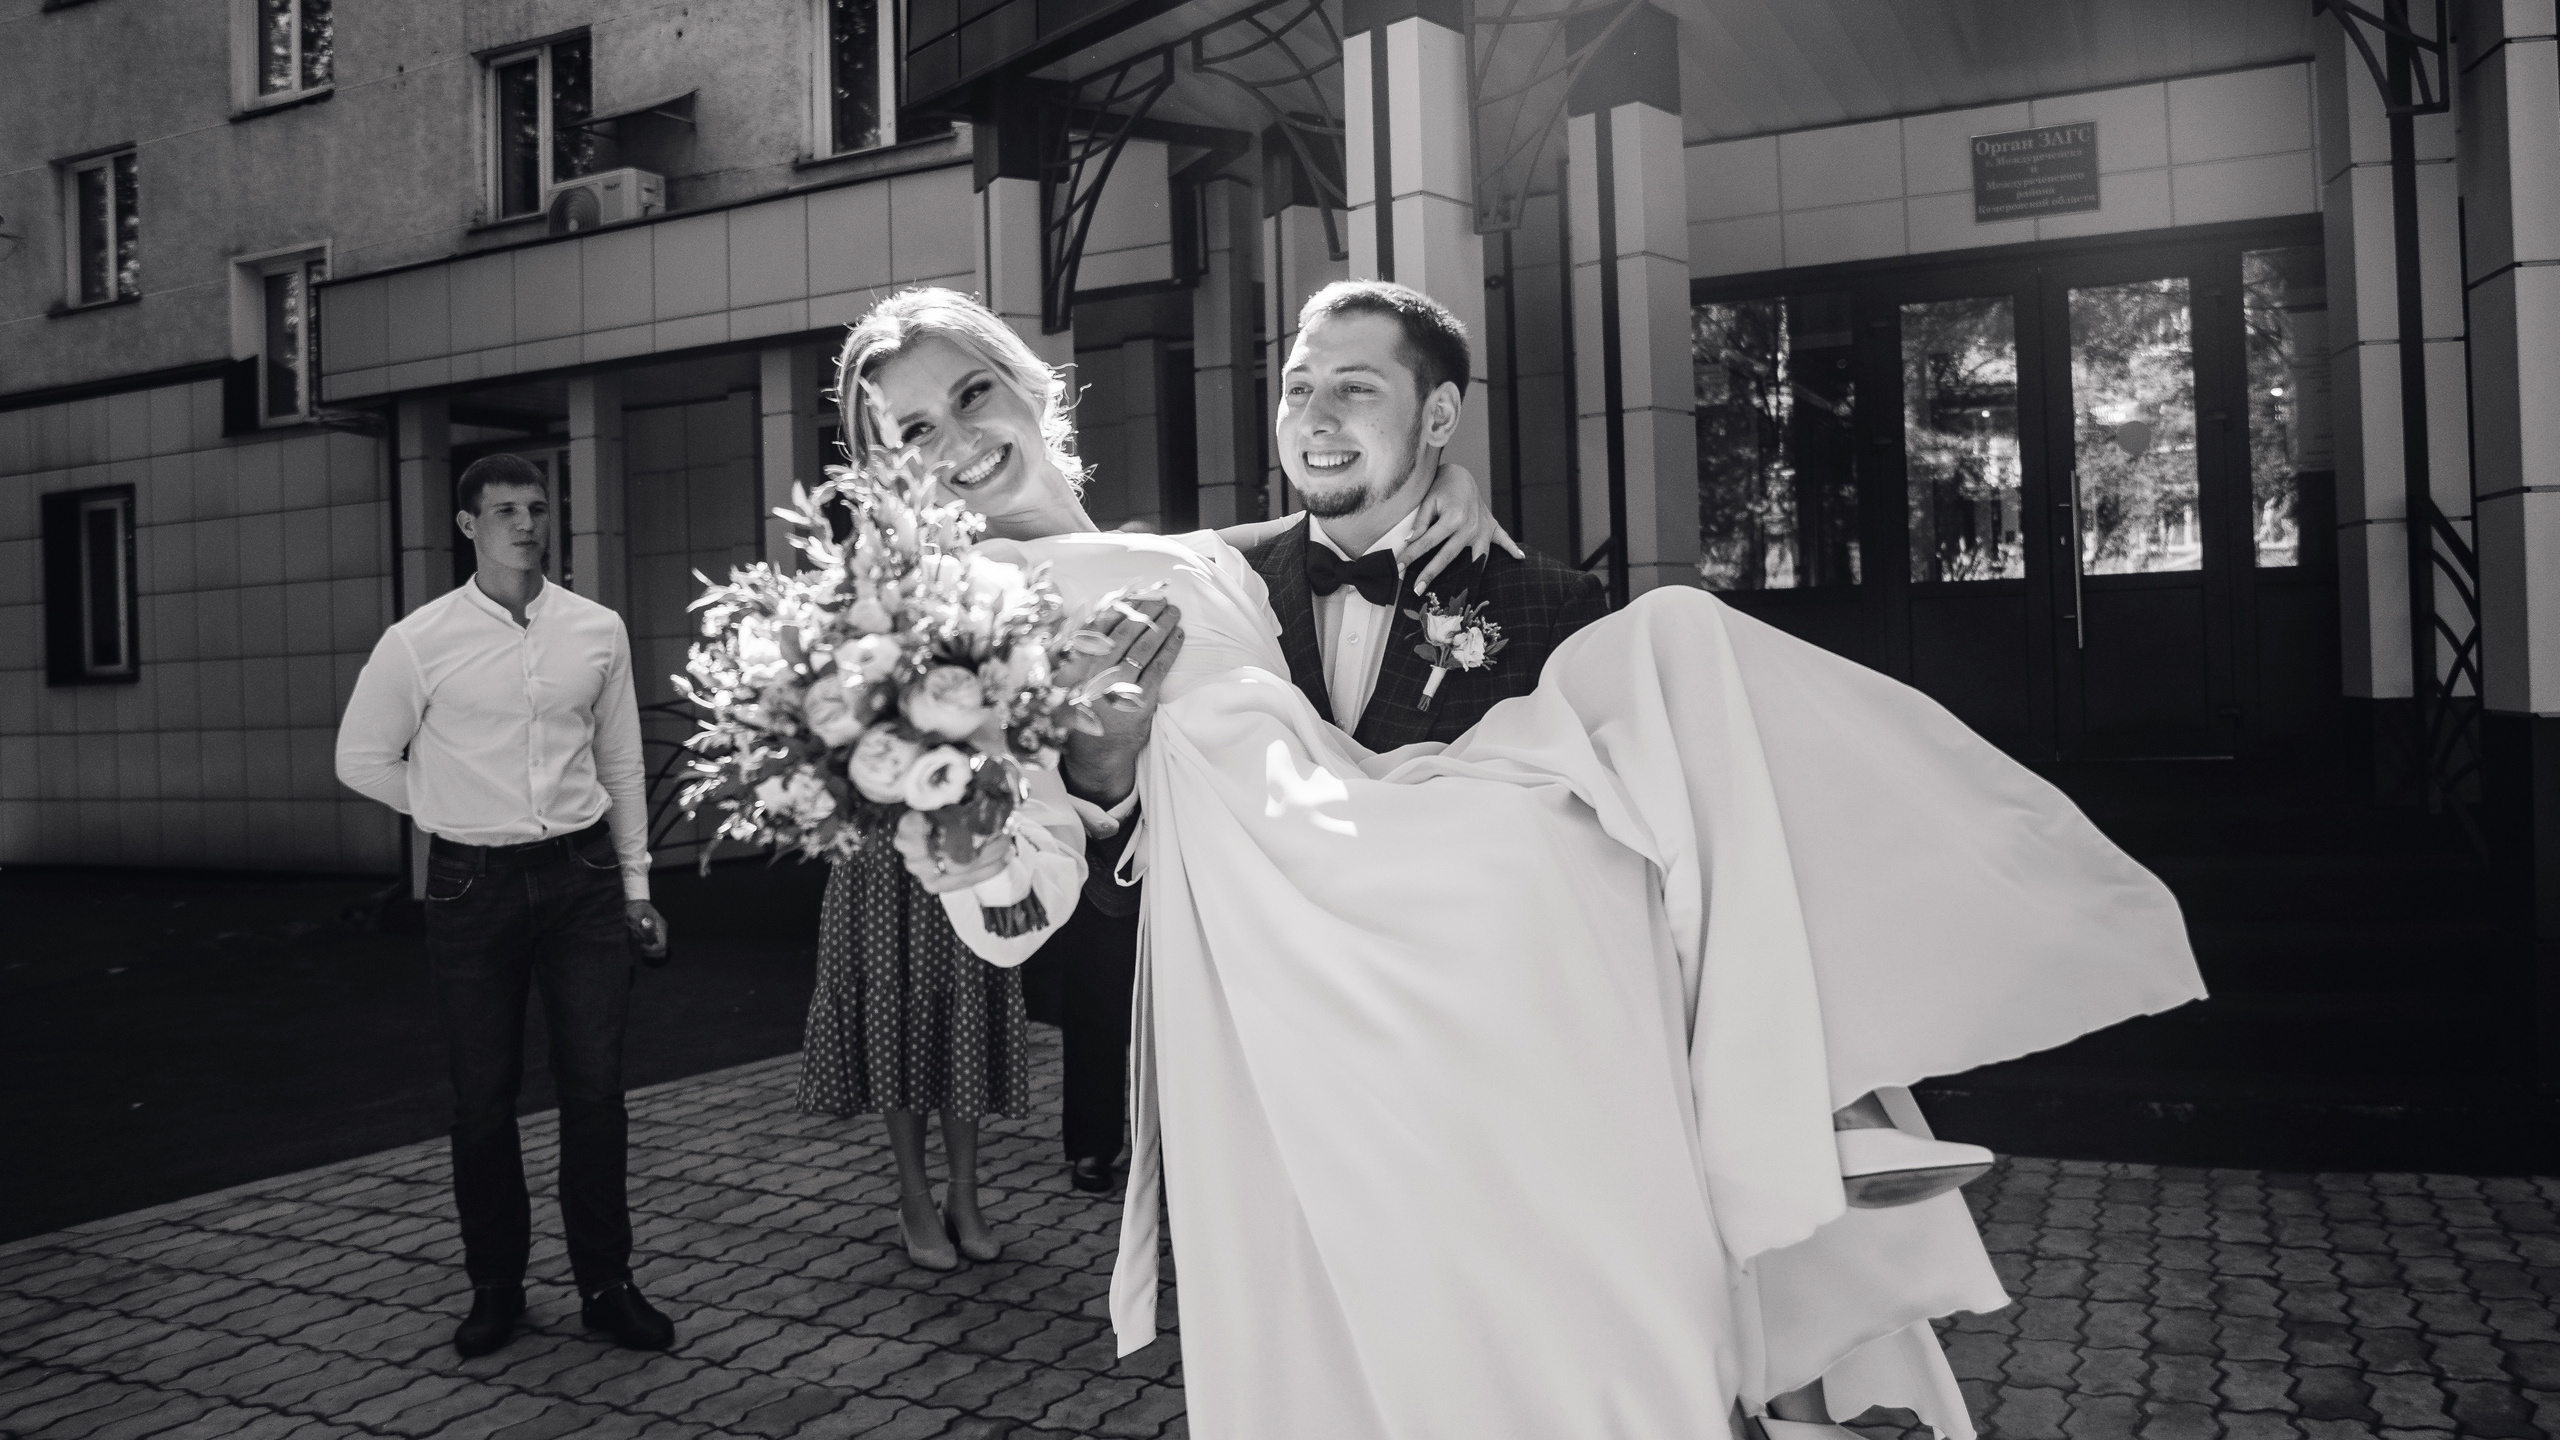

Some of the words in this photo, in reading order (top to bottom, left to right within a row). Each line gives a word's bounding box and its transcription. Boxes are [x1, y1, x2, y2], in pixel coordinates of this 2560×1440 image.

[1975, 138, 2035, 157] Орган
[2038, 127, 2090, 148] ЗАГС
[2030, 165, 2038, 173] и
